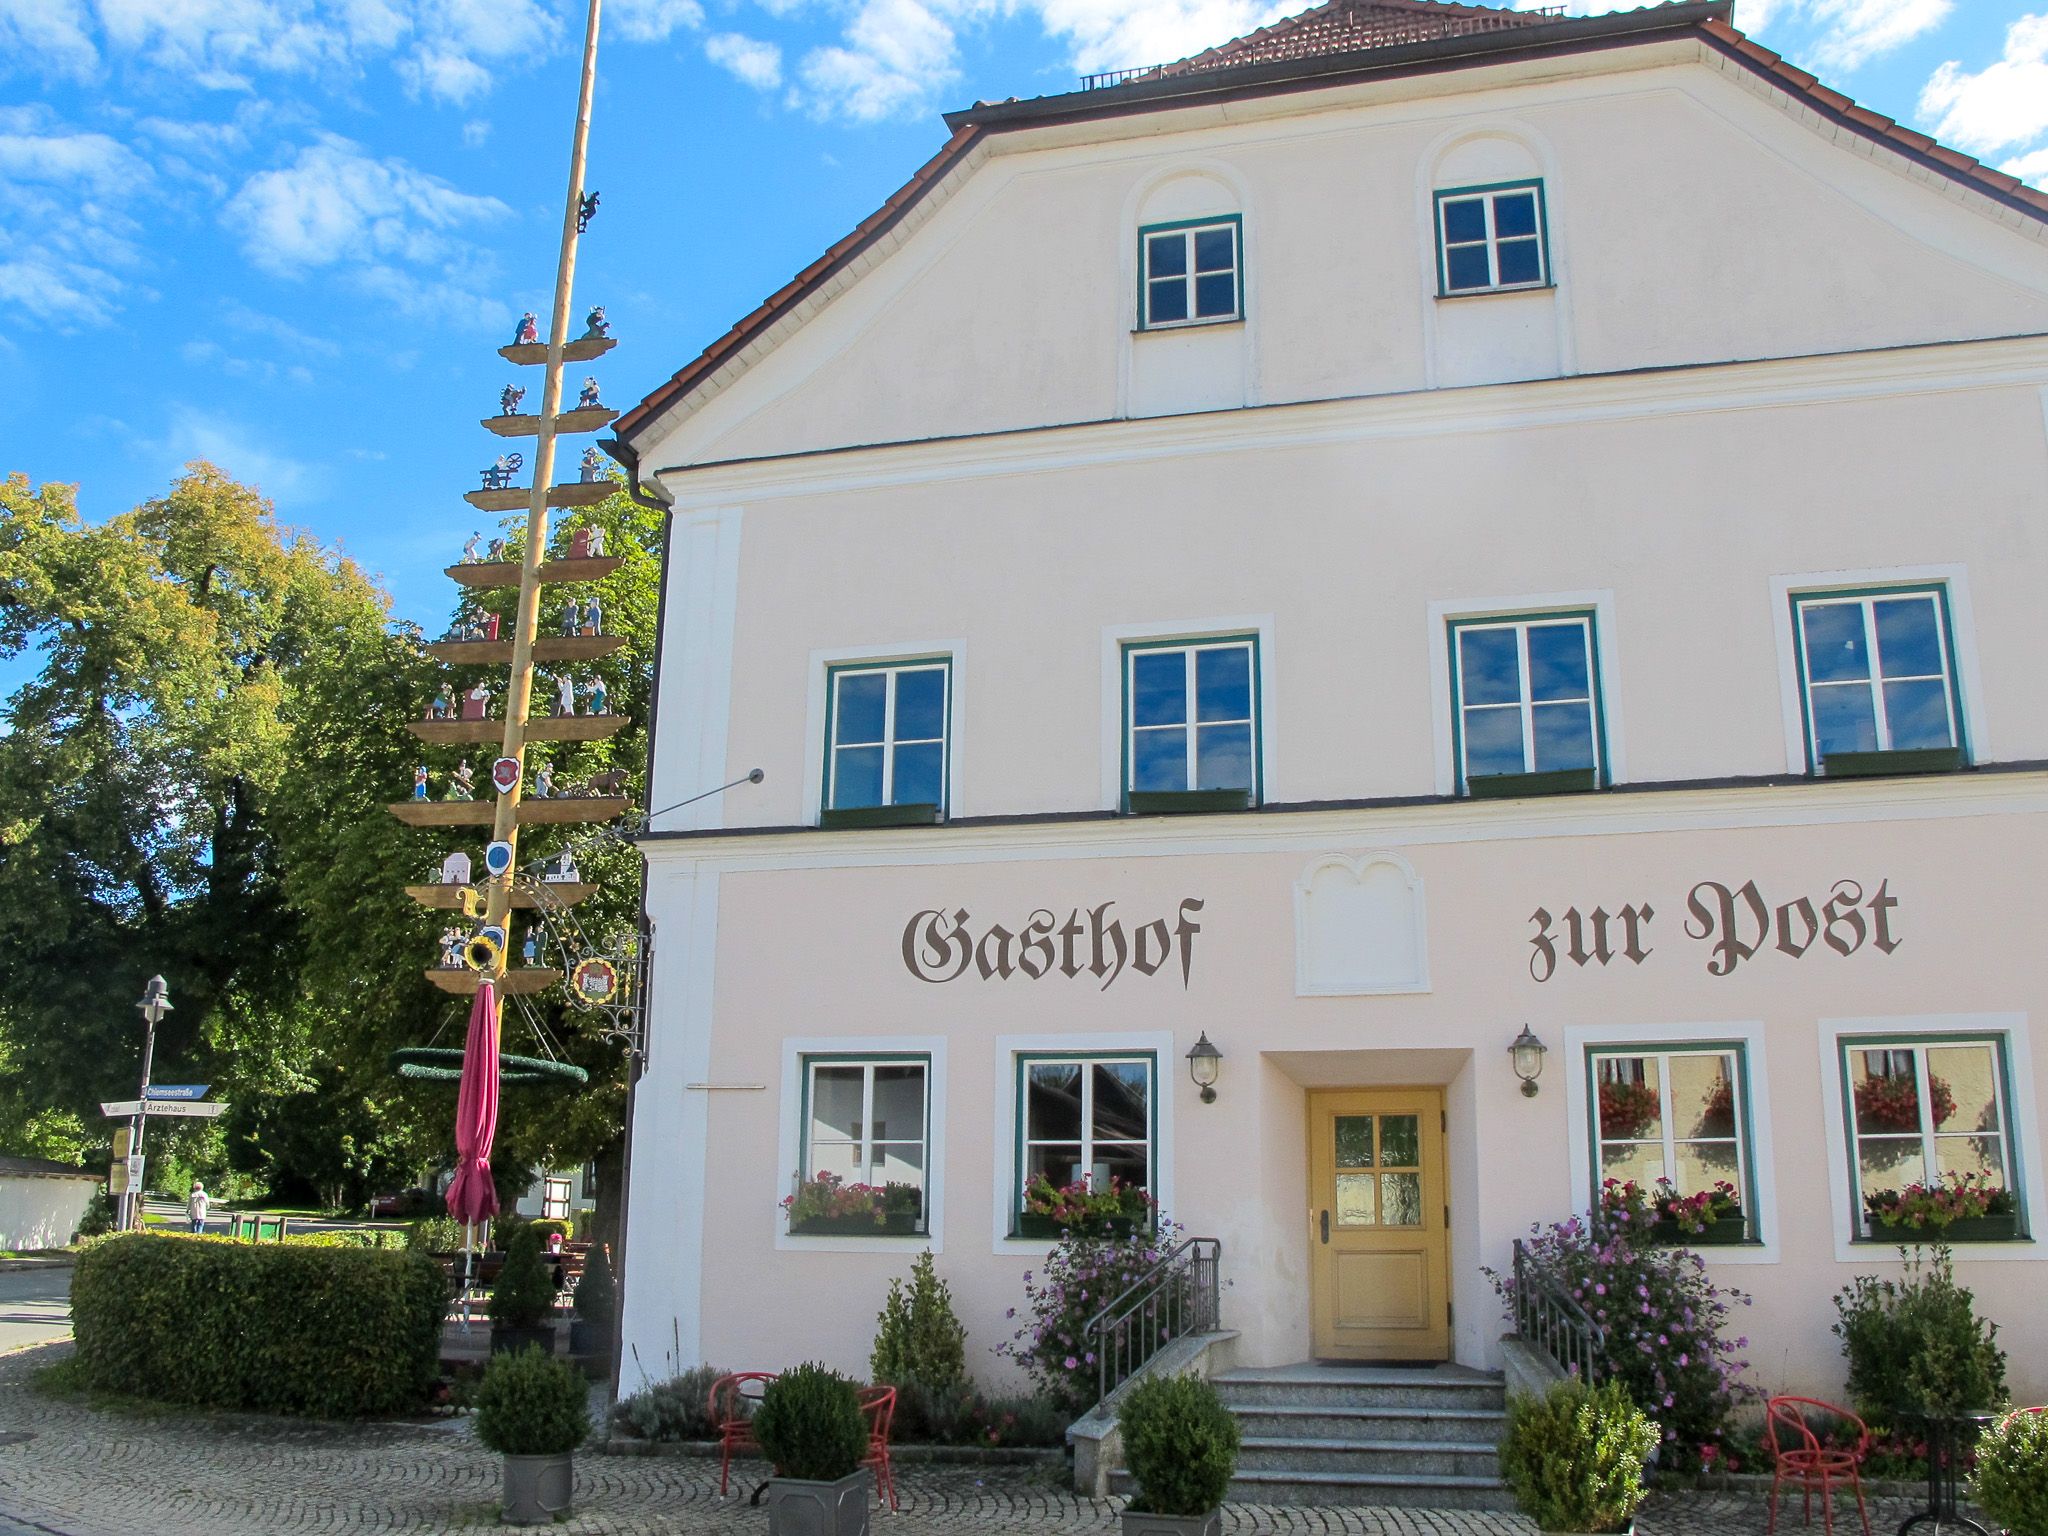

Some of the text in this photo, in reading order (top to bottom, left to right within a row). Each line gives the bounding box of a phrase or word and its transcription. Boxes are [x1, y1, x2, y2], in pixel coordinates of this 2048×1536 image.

[901, 878, 1903, 992] Gasthof zur Post
